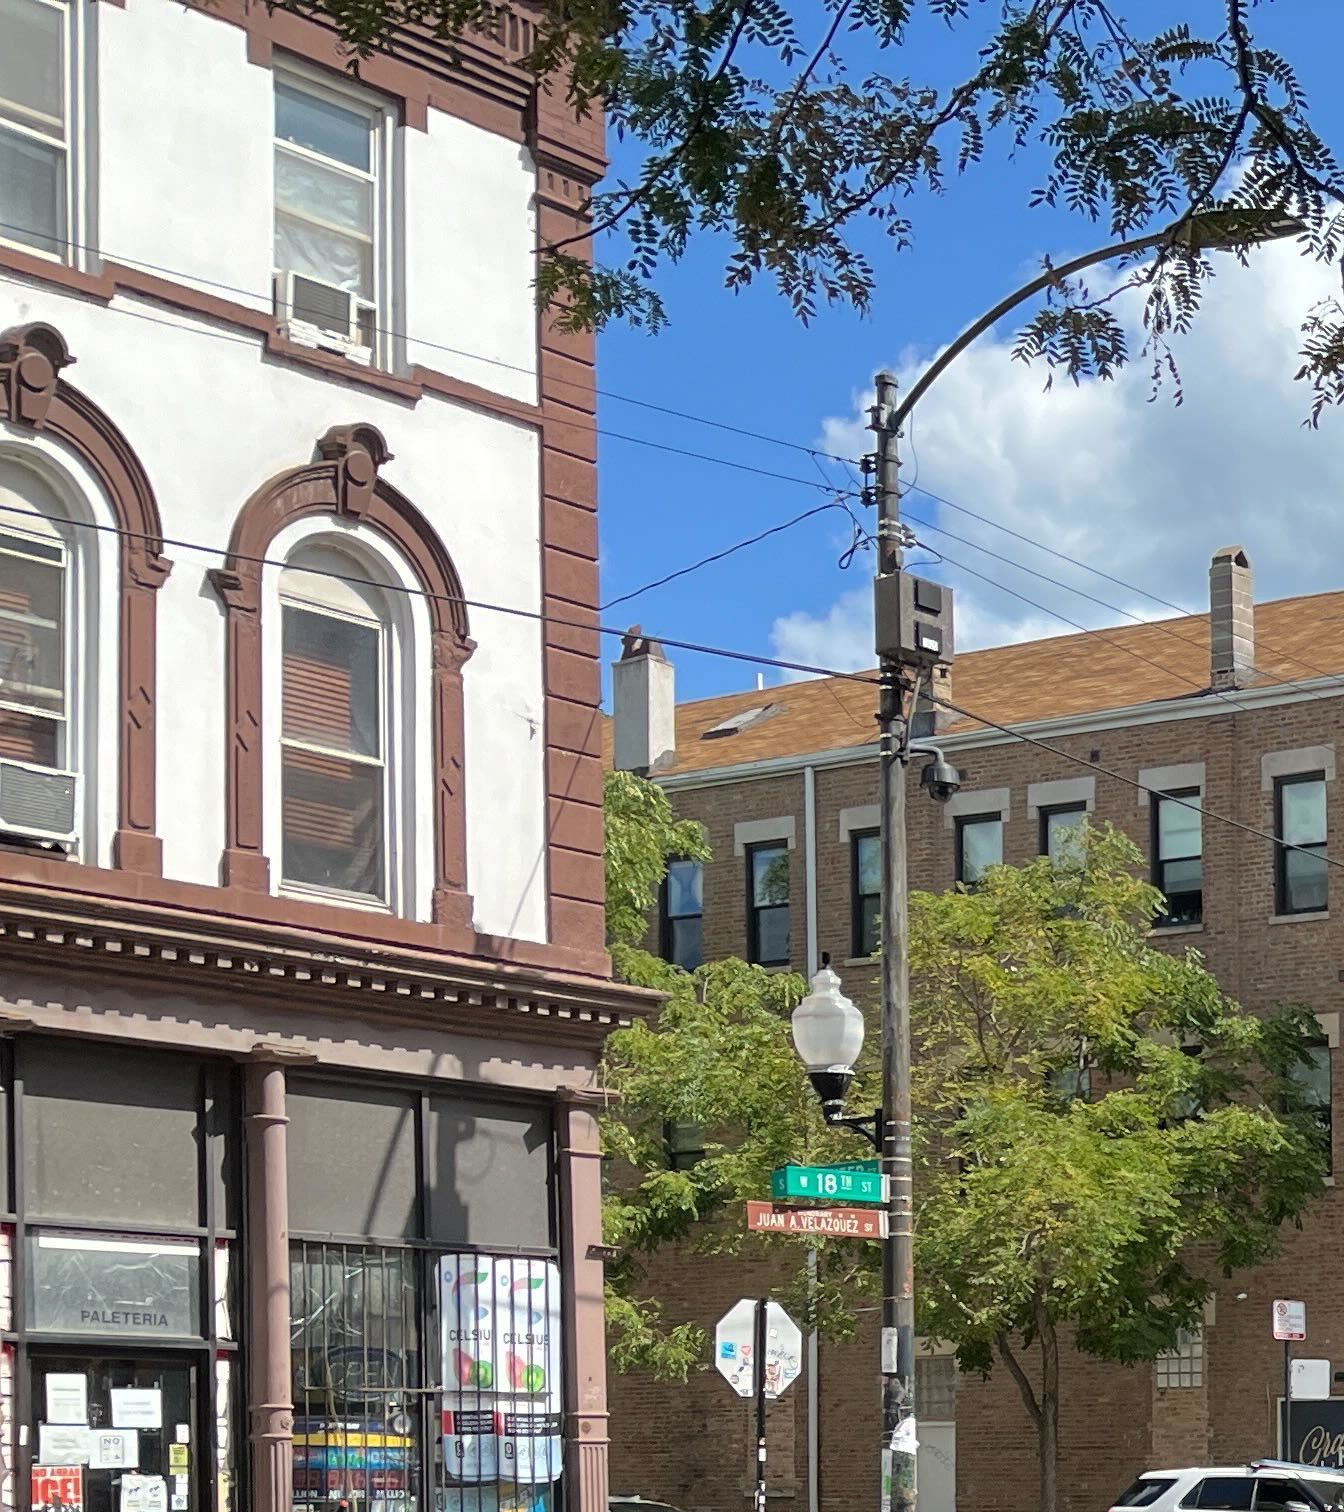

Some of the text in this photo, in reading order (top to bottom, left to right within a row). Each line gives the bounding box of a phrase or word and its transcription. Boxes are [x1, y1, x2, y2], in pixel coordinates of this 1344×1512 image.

[816, 1173, 853, 1195] 18TH
[861, 1181, 873, 1193] ST
[757, 1212, 785, 1228] JUAN
[80, 1310, 168, 1327] PALETERIA
[103, 1437, 120, 1446] NO
